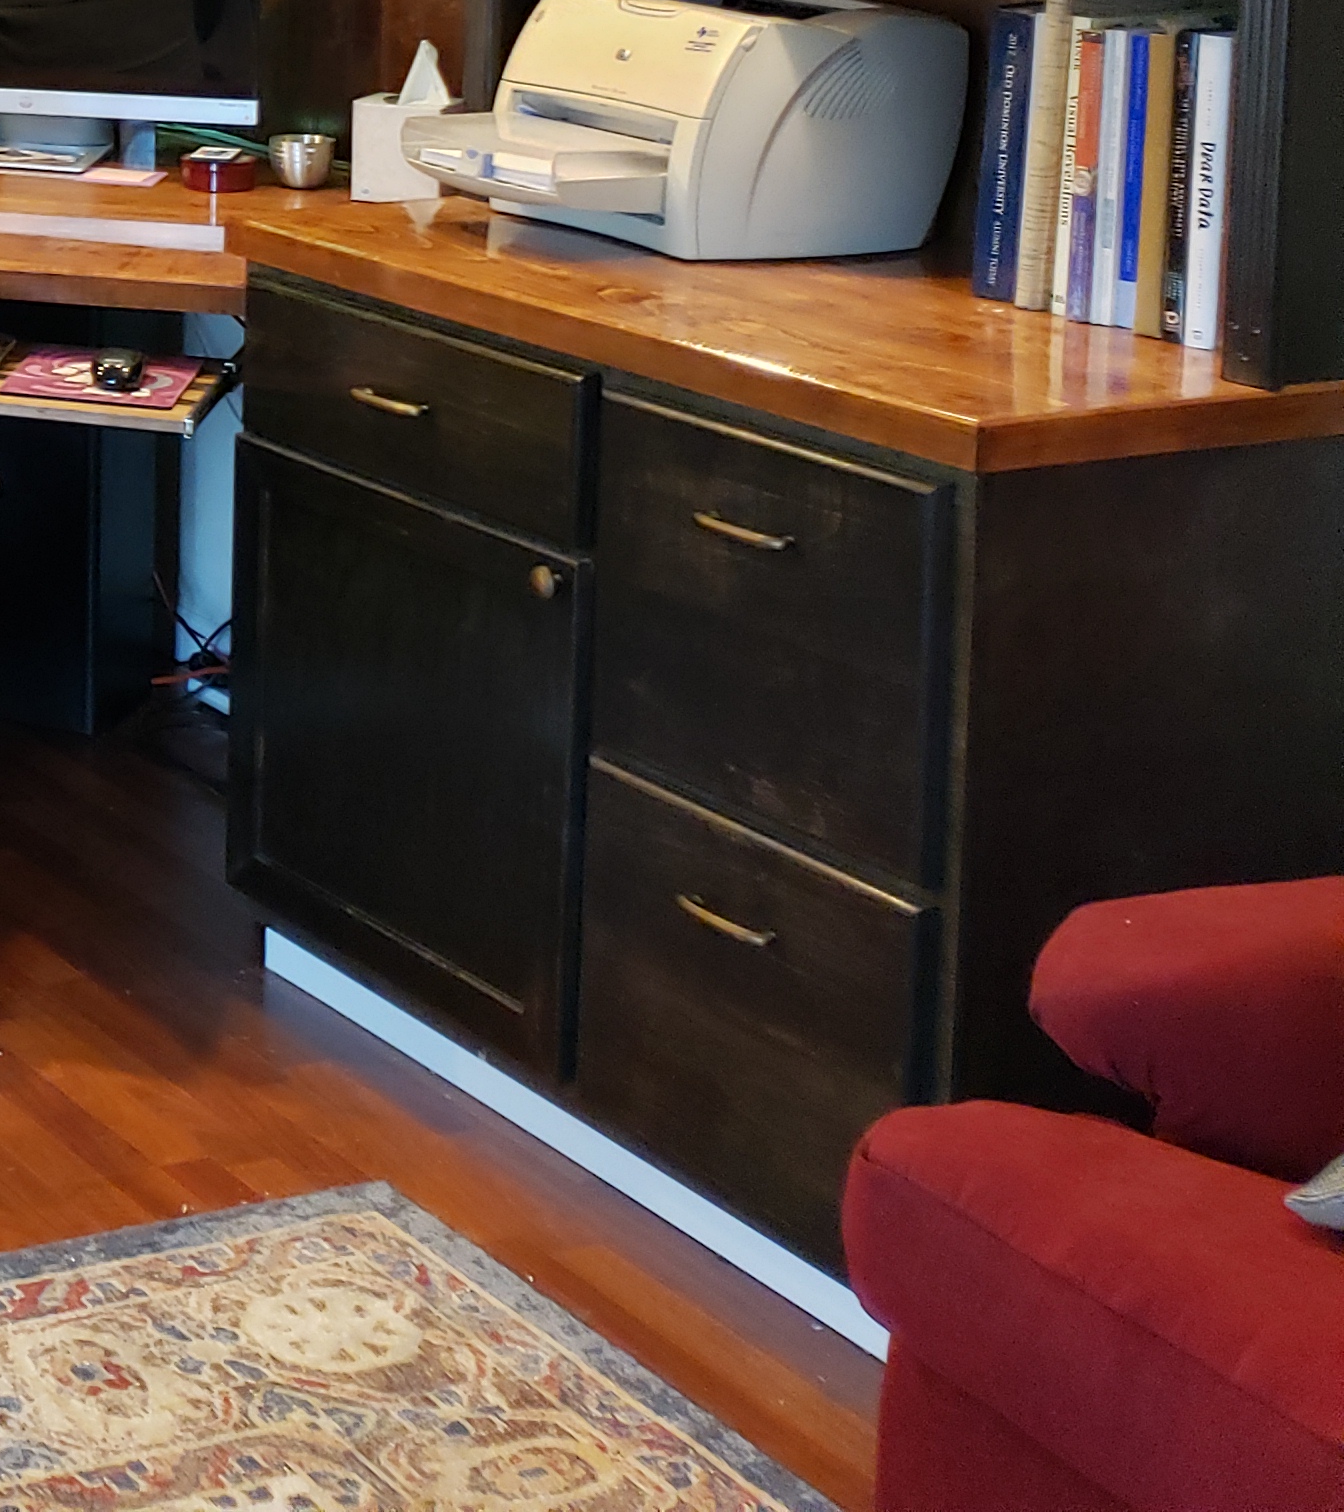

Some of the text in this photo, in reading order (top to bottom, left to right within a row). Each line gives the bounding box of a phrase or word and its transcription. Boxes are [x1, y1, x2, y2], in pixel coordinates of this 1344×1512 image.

[1004, 65, 1015, 88] OLD
[998, 91, 1013, 151] DOMINION
[993, 154, 1009, 215] UNIVERSITY
[1197, 188, 1214, 231] Data
